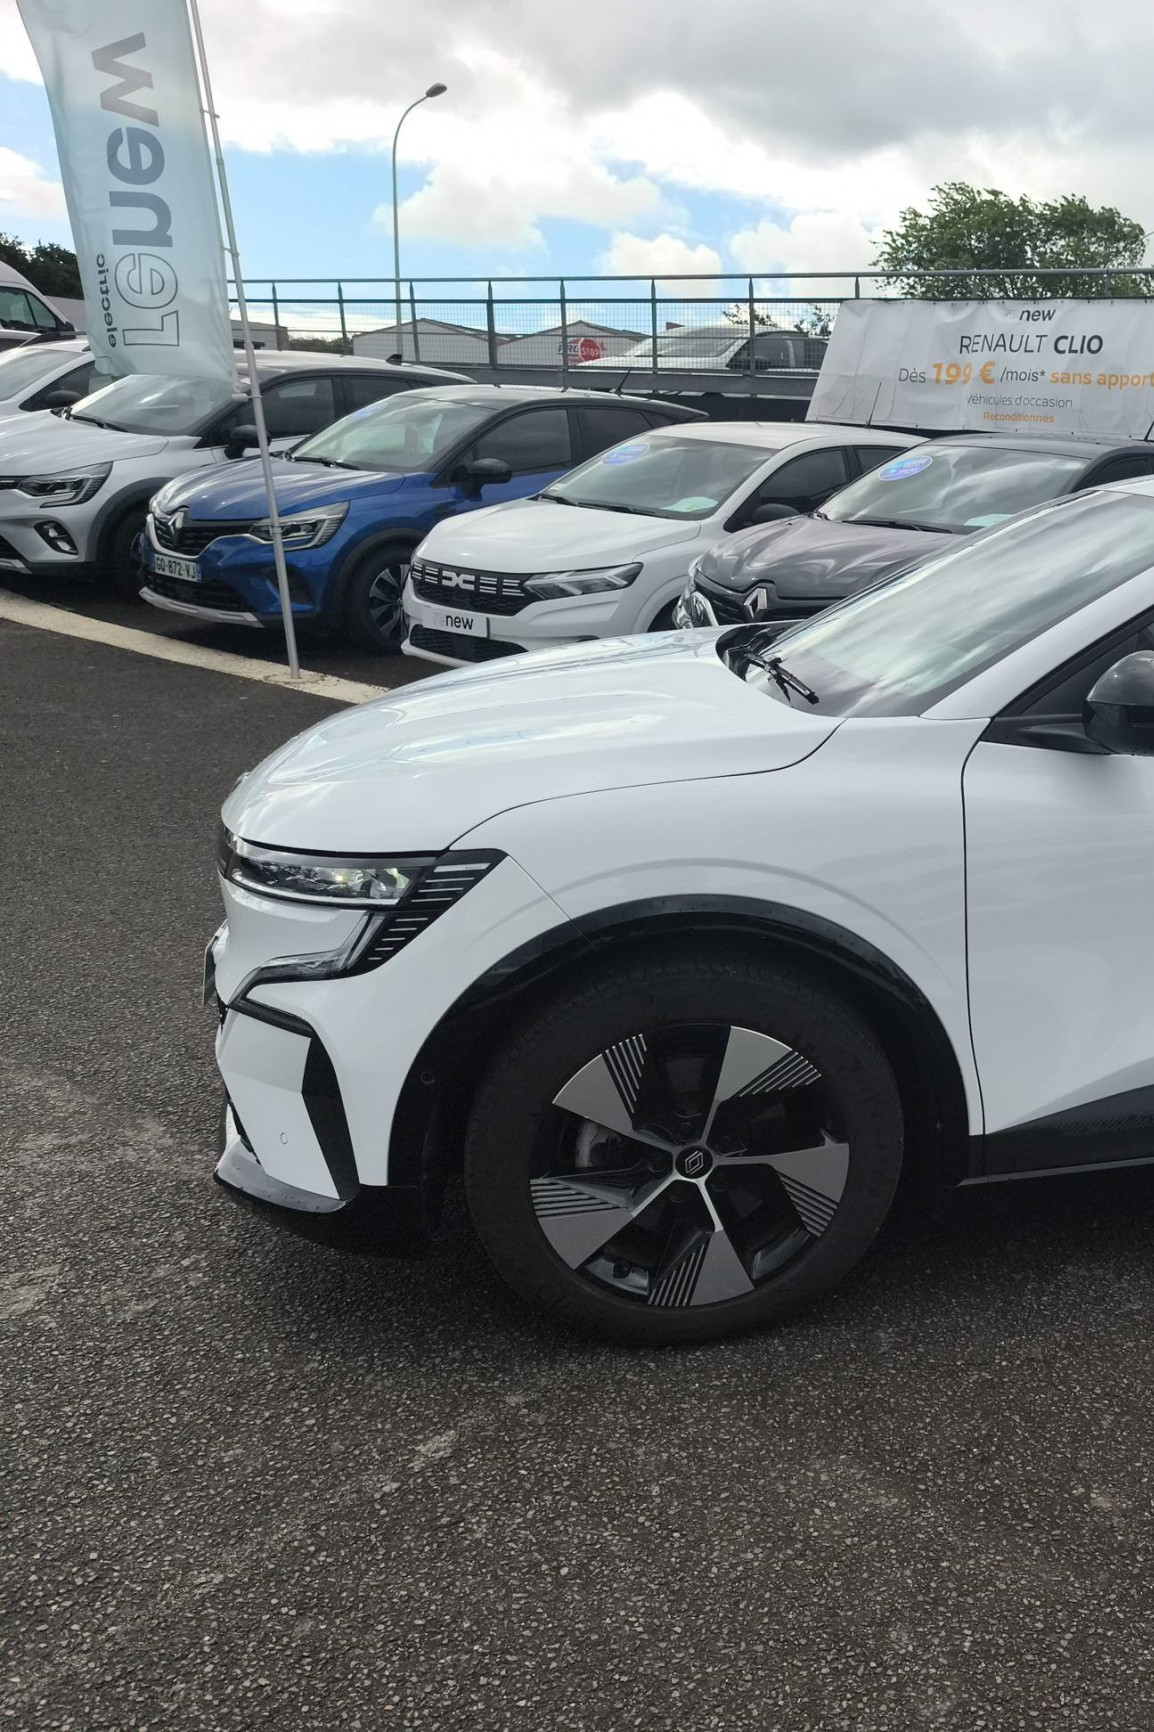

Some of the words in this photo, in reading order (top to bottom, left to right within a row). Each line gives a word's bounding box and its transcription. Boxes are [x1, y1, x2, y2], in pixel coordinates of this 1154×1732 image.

[959, 333, 1049, 355] RENAULT
[1053, 334, 1104, 355] CLIO
[898, 367, 927, 384] Dès
[980, 360, 997, 385] €
[1050, 371, 1093, 386] sans
[983, 411, 1056, 424] Reconditionnés
